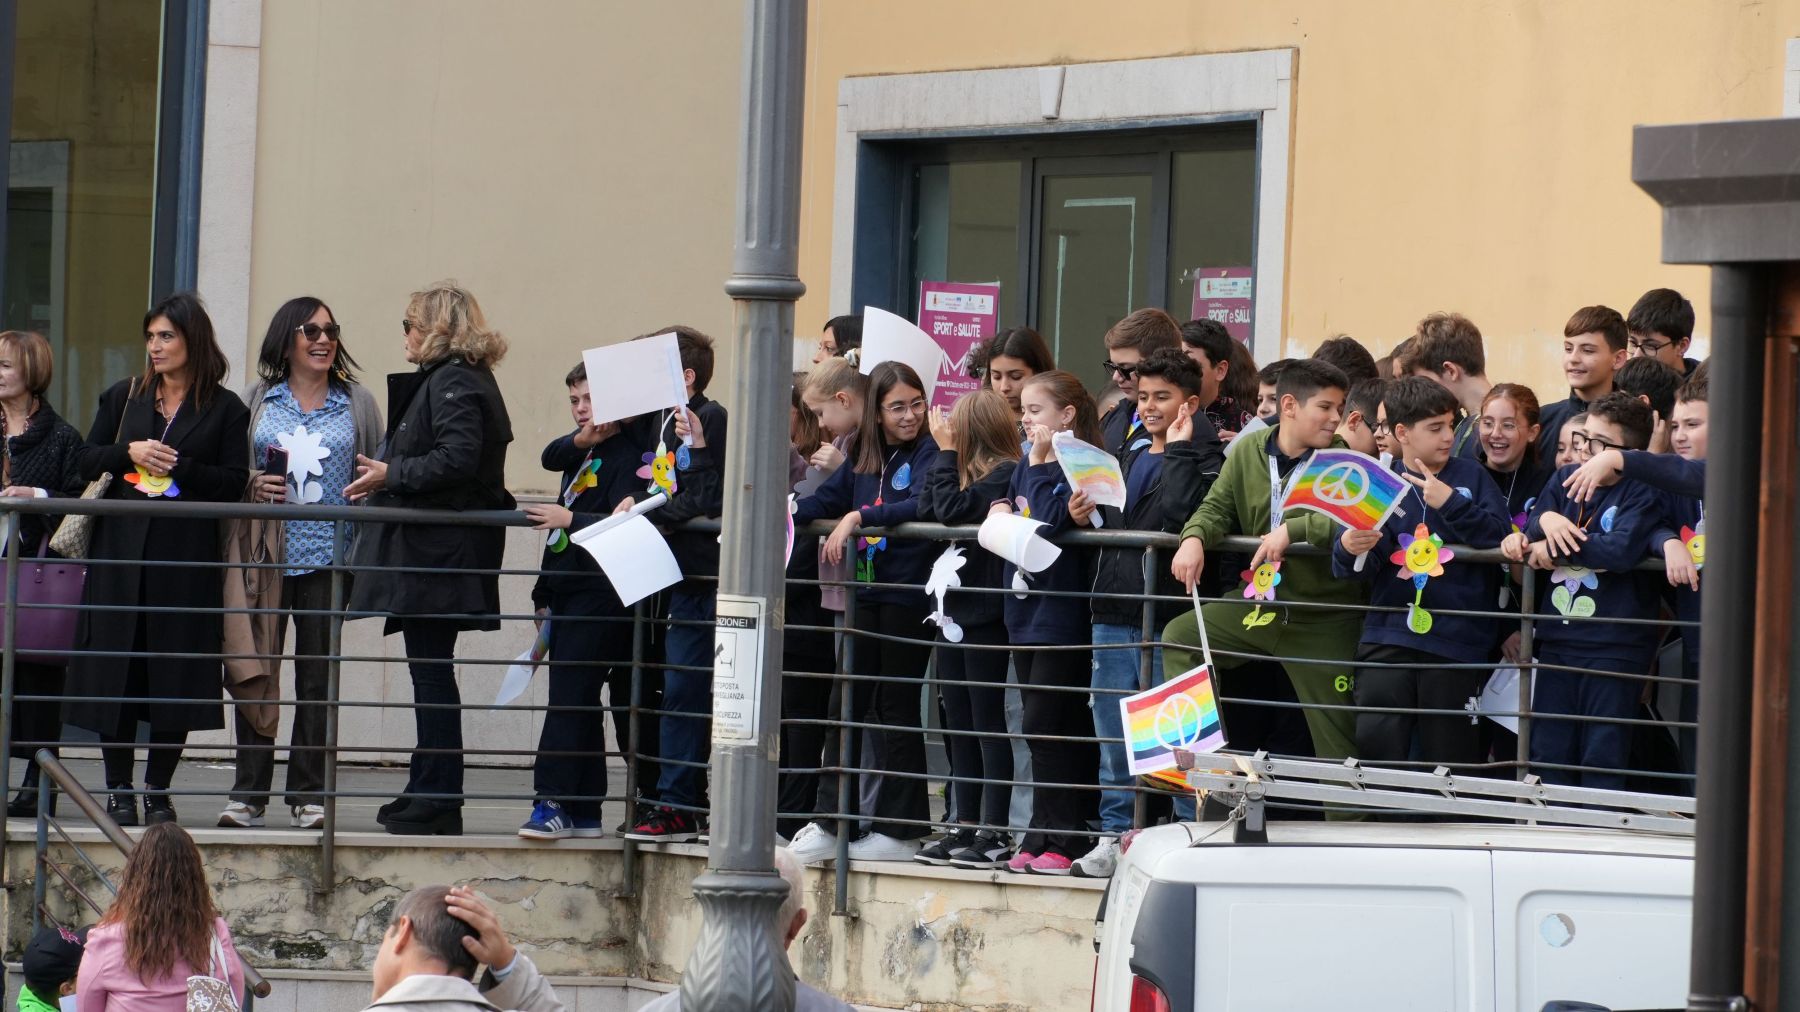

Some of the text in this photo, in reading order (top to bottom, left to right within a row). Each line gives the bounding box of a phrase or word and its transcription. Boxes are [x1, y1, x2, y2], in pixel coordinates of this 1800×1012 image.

[1208, 309, 1229, 323] SPORT
[1229, 312, 1234, 323] e
[933, 321, 981, 338] SPORT e SALUTE
